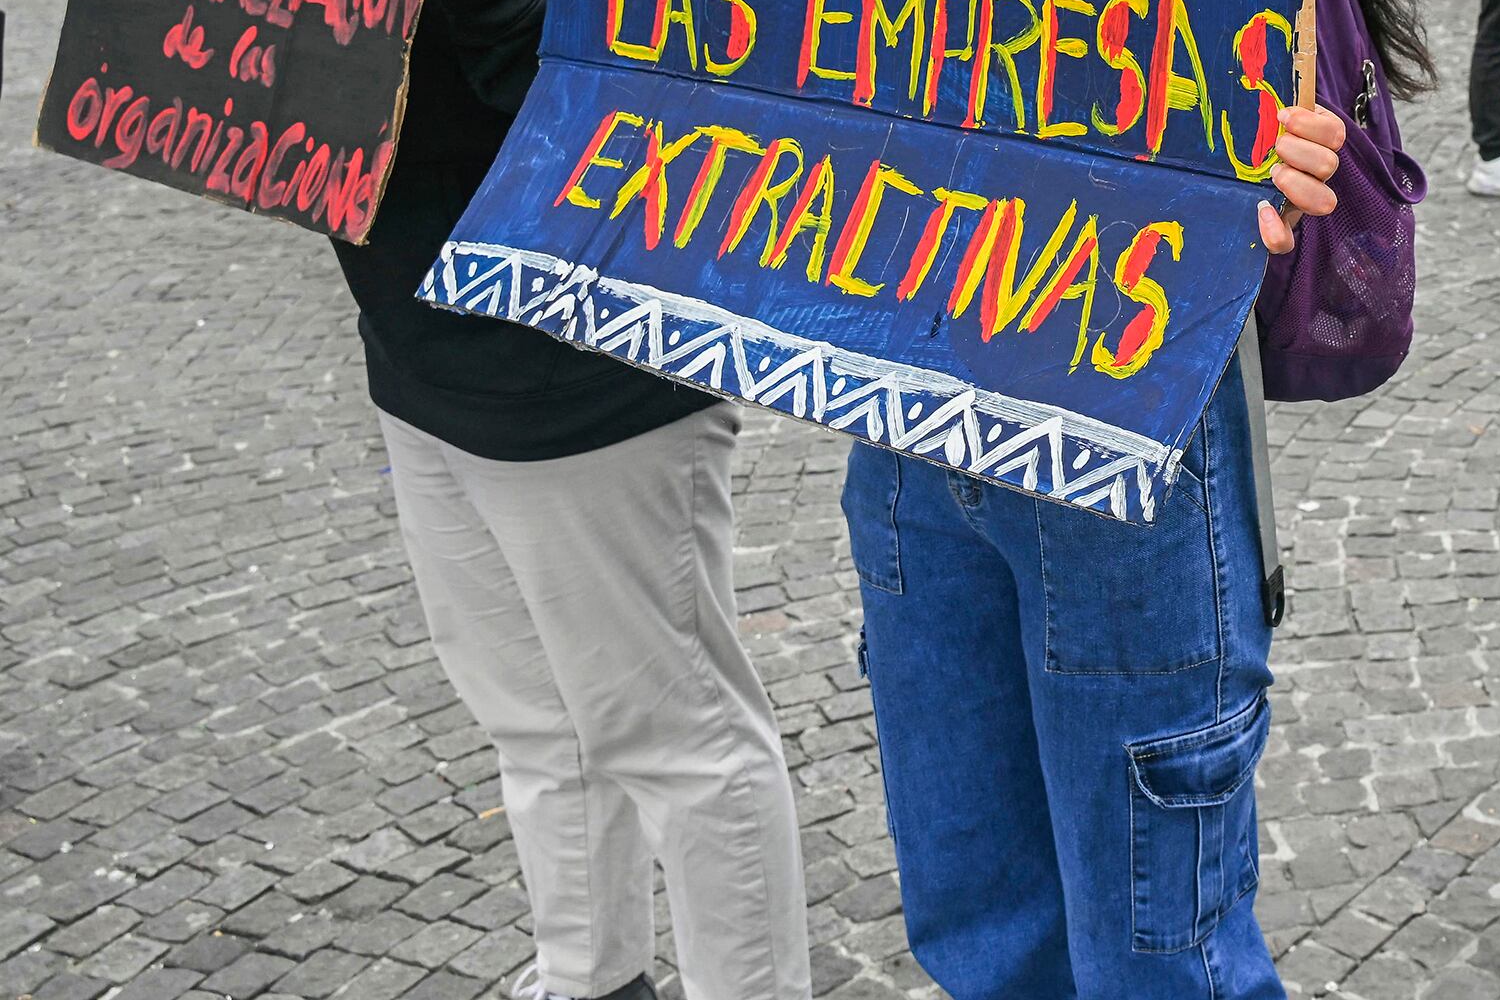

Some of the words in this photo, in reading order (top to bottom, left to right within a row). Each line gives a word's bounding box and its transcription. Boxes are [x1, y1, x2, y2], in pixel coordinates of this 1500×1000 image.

[163, 4, 214, 69] de
[229, 26, 276, 88] las
[553, 109, 1185, 379] EXTRACTIVAS
